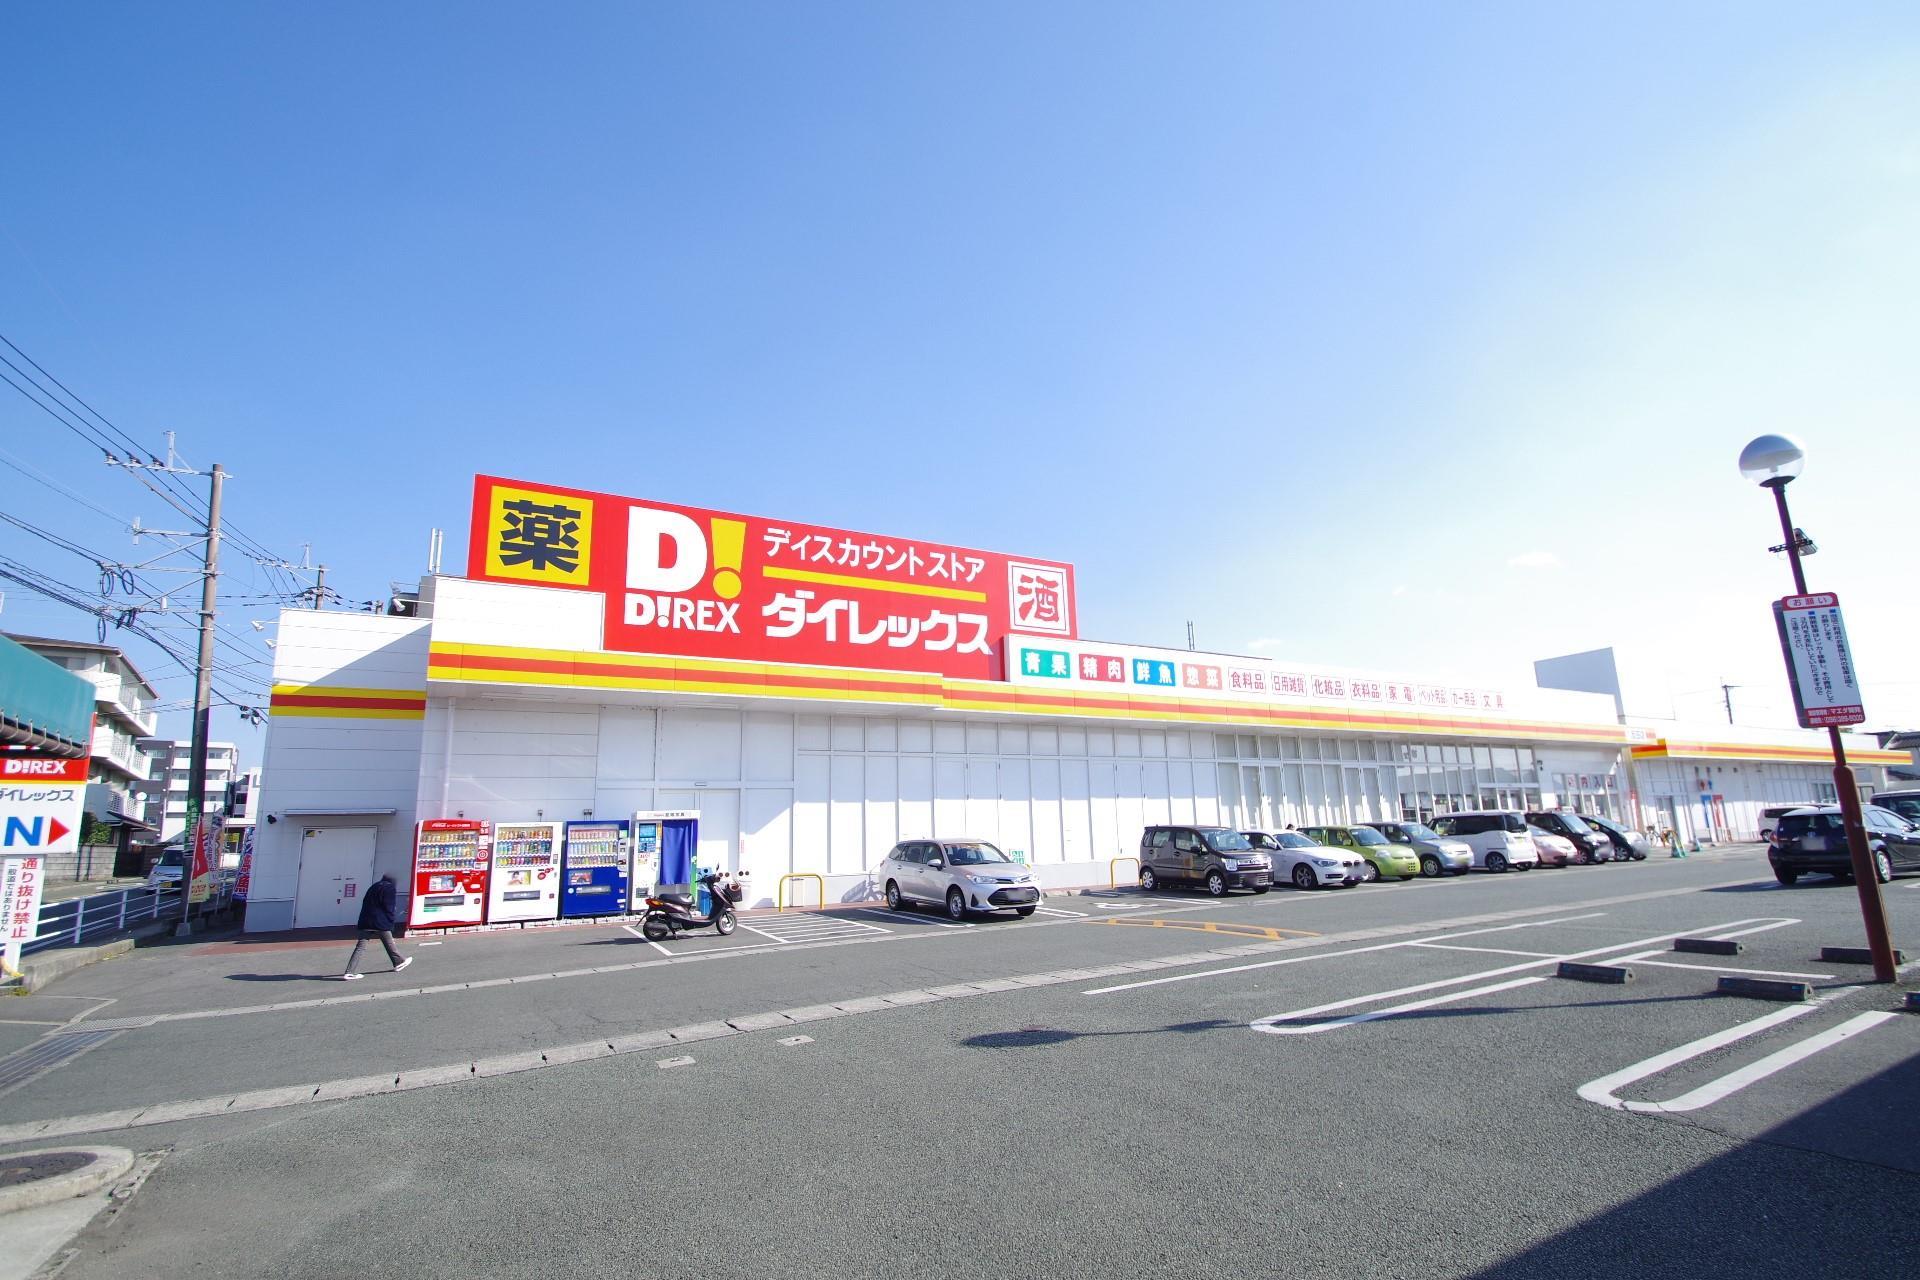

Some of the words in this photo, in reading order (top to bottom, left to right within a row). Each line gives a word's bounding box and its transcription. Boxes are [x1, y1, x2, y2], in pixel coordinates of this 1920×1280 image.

[498, 499, 581, 573] 薬
[762, 589, 993, 655] ダイレックス
[1016, 572, 1061, 624] 酒
[1792, 597, 1828, 607] お願い
[1025, 651, 1067, 676] 青果
[1083, 656, 1122, 680] 精肉
[1136, 661, 1173, 685] 鮮魚
[1230, 671, 1265, 691] 食料品
[1273, 675, 1305, 694] 日用雑貨
[1313, 679, 1344, 697] 化粧品
[1352, 681, 1380, 699] 衣料品
[11, 857, 39, 939] 通り抜け禁止
